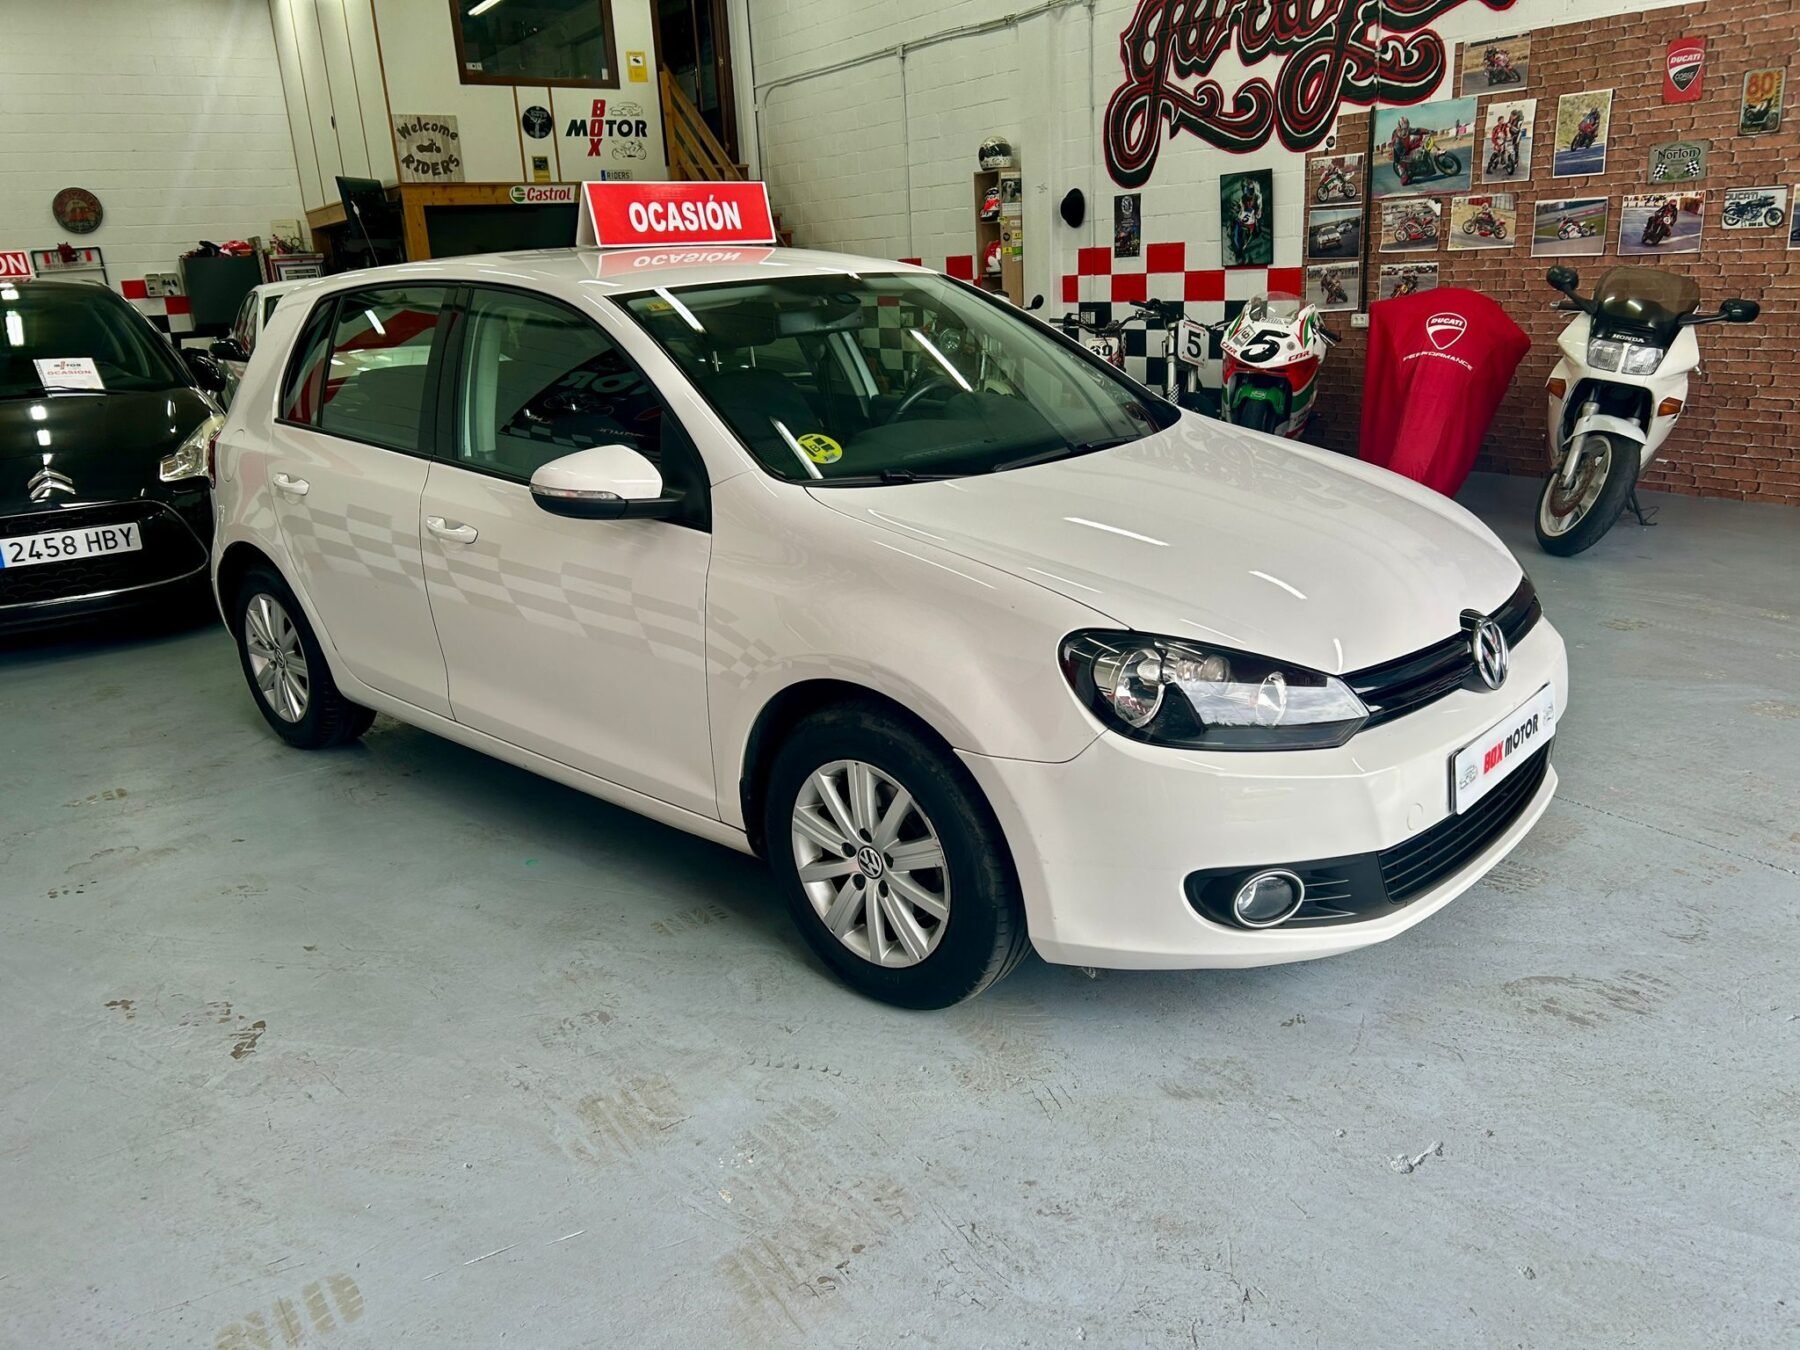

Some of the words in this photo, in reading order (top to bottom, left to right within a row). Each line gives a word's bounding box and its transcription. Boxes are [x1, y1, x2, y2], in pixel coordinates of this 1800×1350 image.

[1670, 53, 1702, 64] DUCATI
[396, 117, 459, 141] Welcome
[1655, 146, 1701, 161] Norton
[401, 154, 460, 177] RIDERS
[607, 171, 631, 180] RIDERS
[527, 187, 572, 202] Castrol
[628, 194, 743, 233] OCASIÓN
[1430, 317, 1464, 327] DUCATI
[1187, 330, 1202, 359] 5
[1240, 329, 1291, 363] 5
[1612, 333, 1645, 344] HONDA
[8, 536, 77, 563] 2458
[85, 526, 133, 553] HBY
[1483, 740, 1504, 775] BOX
[1505, 713, 1539, 758] MOTOR
